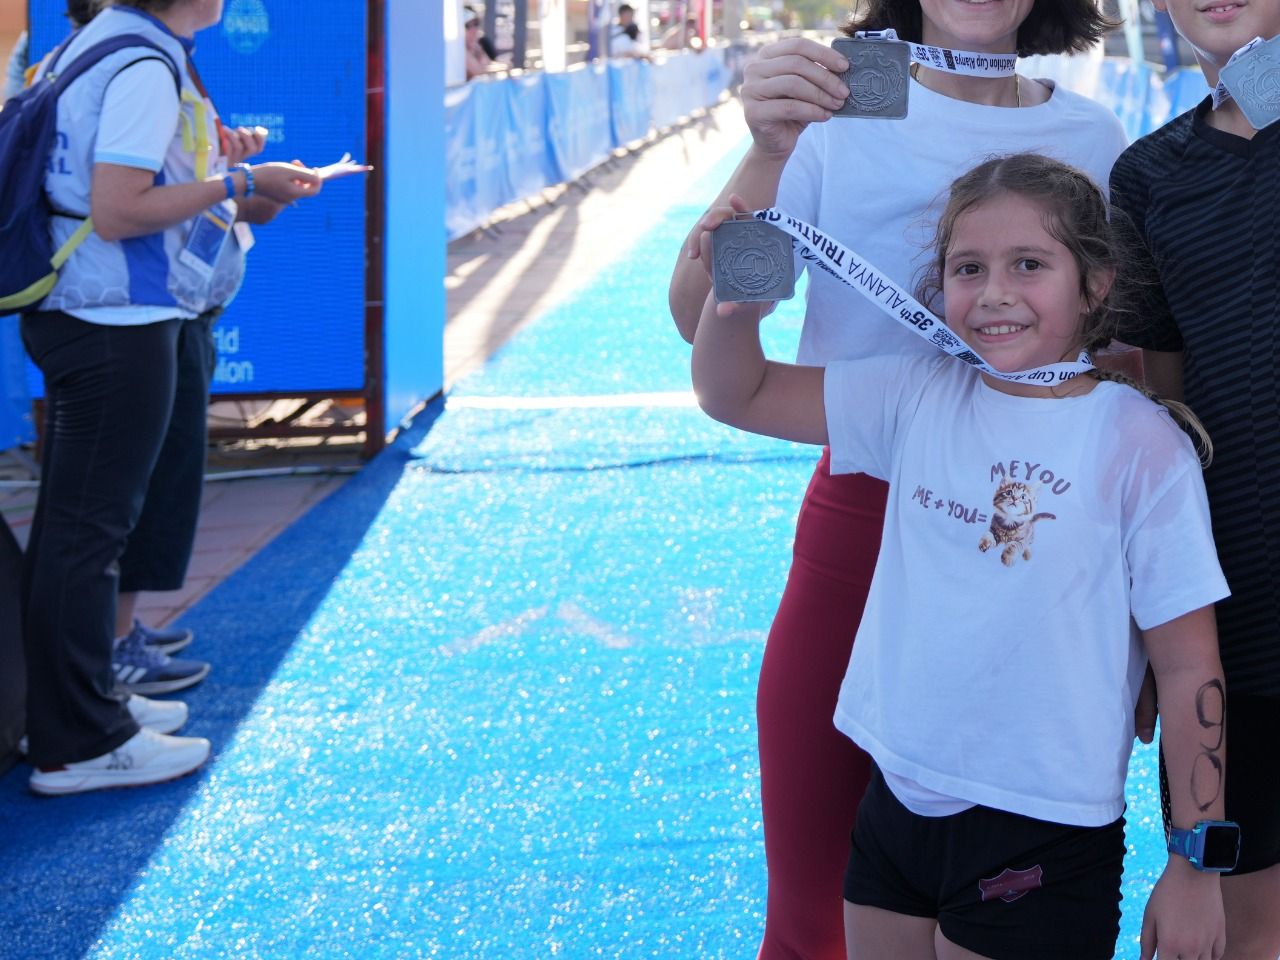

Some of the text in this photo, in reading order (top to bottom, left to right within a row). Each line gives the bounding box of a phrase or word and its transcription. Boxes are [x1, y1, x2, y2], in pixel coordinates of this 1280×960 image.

[976, 54, 989, 71] Cup
[848, 257, 909, 310] ALANYA
[899, 306, 934, 333] 35th
[1027, 369, 1055, 383] Cup
